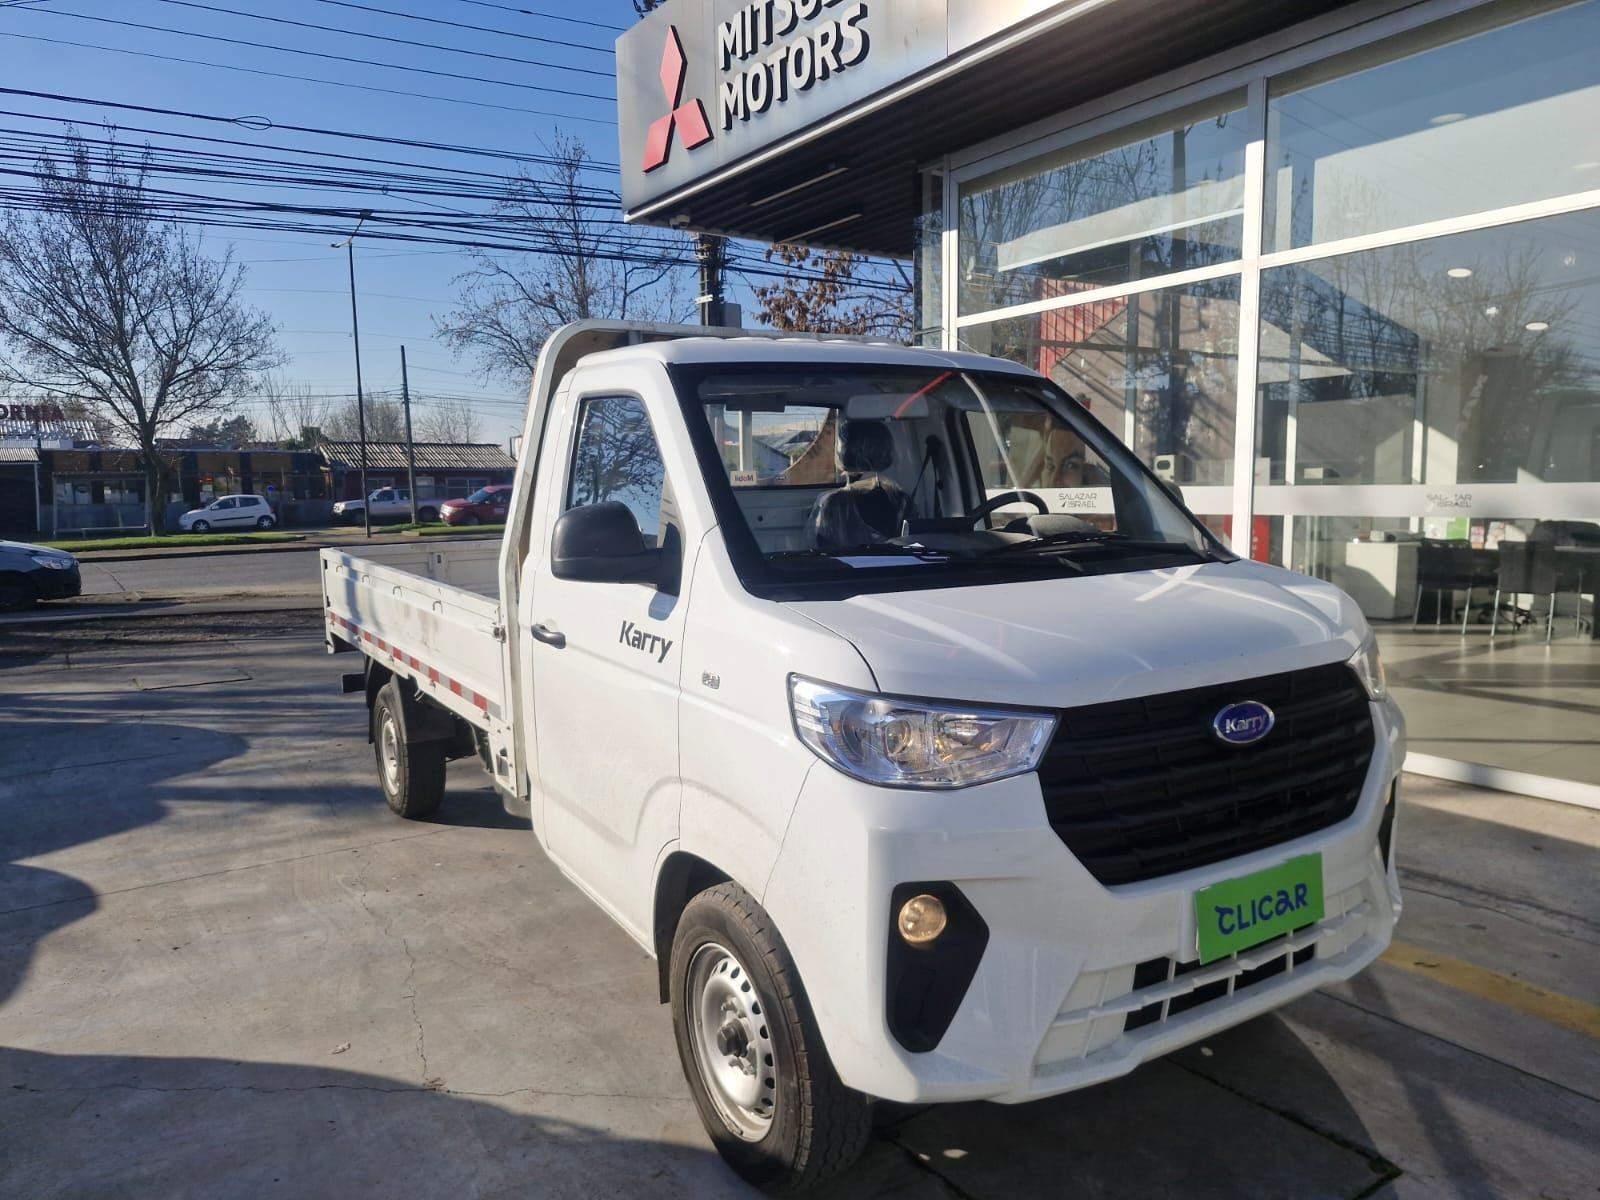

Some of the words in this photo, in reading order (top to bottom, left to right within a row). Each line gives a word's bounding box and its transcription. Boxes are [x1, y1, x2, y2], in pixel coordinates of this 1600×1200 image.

[719, 3, 870, 131] MOTORS
[619, 620, 673, 663] Karry
[1225, 715, 1266, 733] Karry
